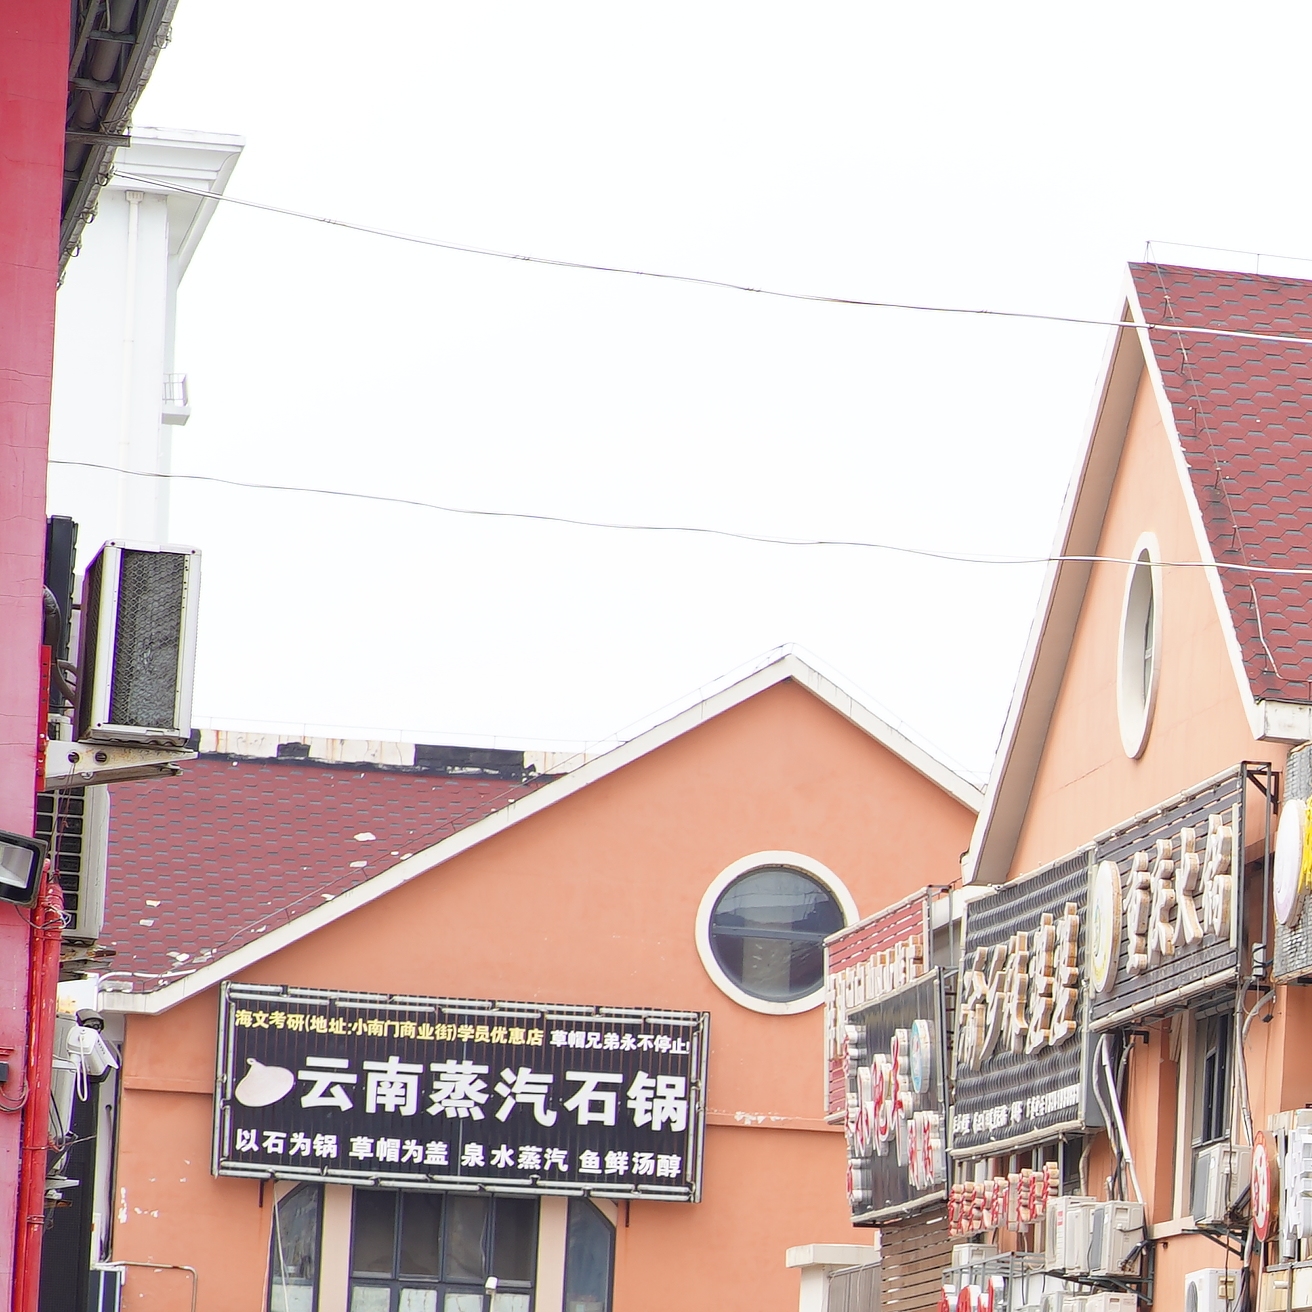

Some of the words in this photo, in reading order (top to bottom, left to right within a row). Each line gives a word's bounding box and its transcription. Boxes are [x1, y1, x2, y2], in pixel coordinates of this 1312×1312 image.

[234, 1009, 545, 1046] 海文考研(地址:小南门商业街)学员优惠店
[297, 1055, 688, 1132] 云南蒸汽石锅
[235, 1128, 338, 1160] 以石为锅
[349, 1136, 449, 1166] 草帽为盖
[461, 1143, 568, 1172] 泉水蒸汽
[578, 1149, 682, 1179] 鱼鲜汤醇
